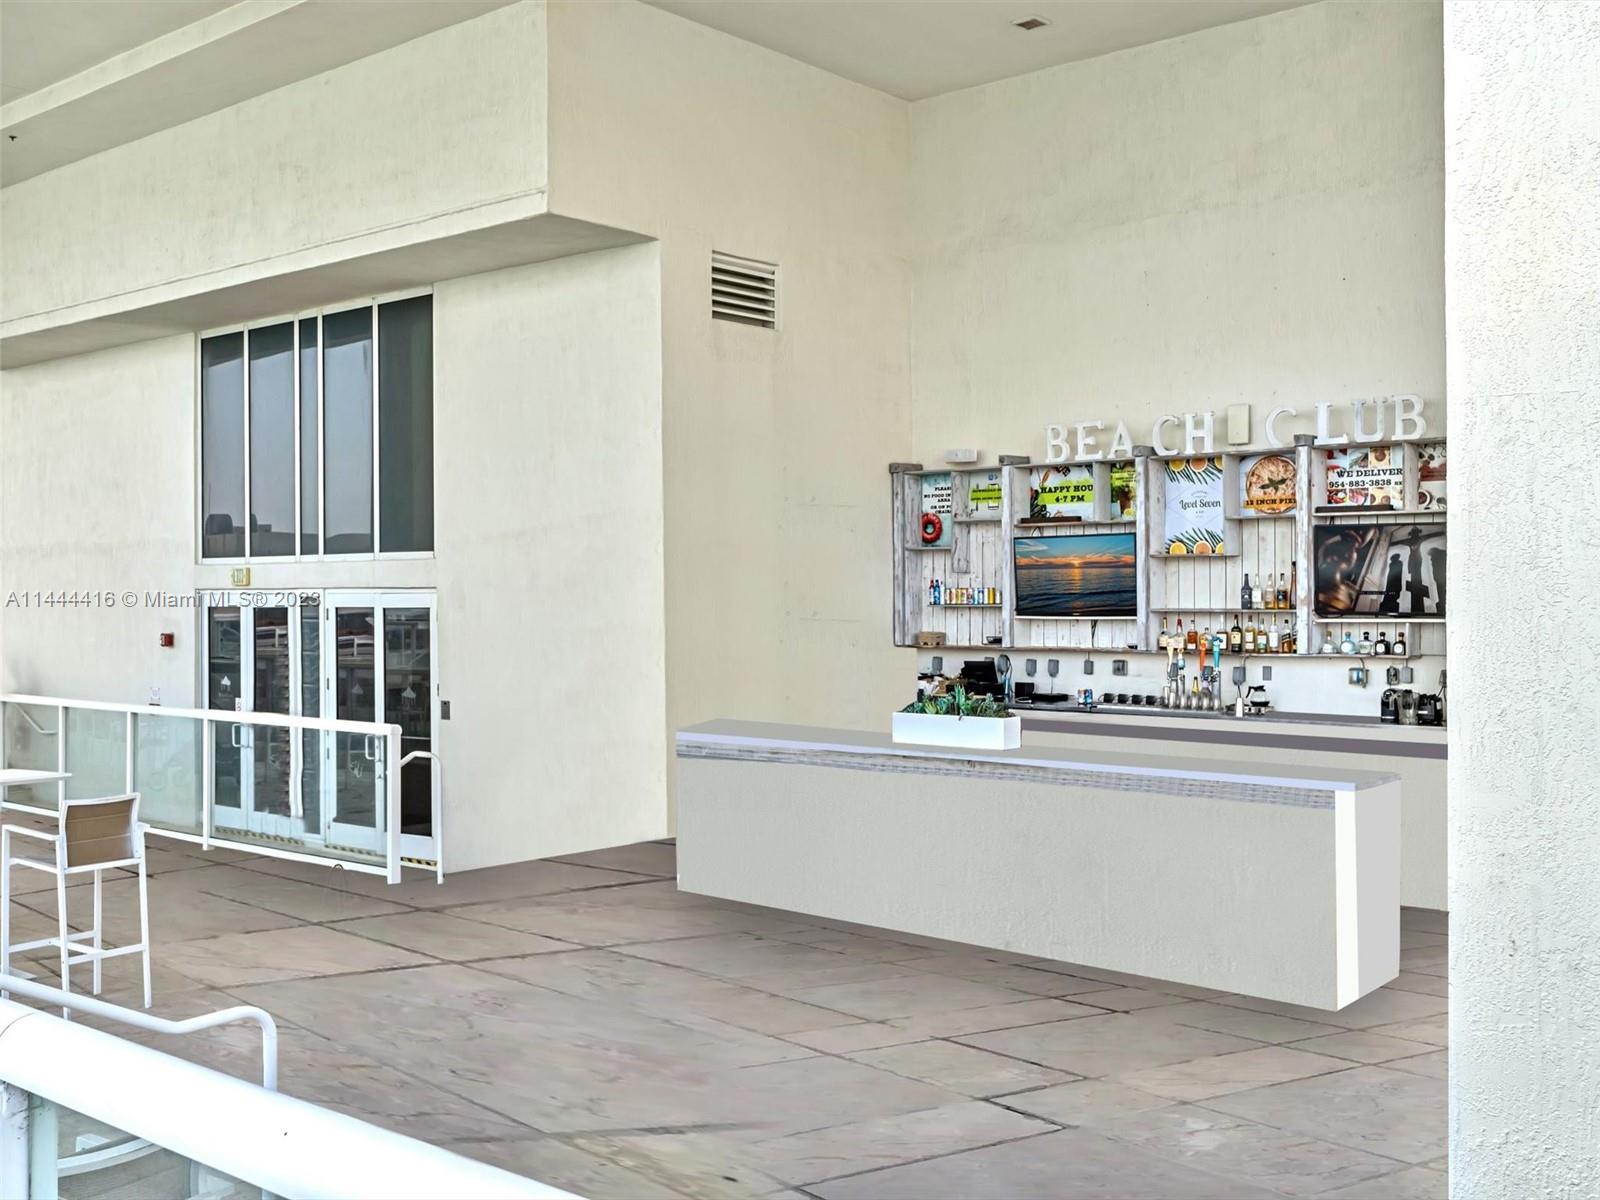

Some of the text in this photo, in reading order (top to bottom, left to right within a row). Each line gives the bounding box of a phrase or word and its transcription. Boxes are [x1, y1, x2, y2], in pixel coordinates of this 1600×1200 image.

[1045, 393, 1427, 463] BEACH CLUB
[1336, 468, 1403, 478] WE DELIVER
[1329, 479, 1392, 489] 954-883-3838
[1040, 485, 1071, 494] HAPPY
[1055, 495, 1068, 503] 4-7
[1179, 498, 1222, 511] Level Seven
